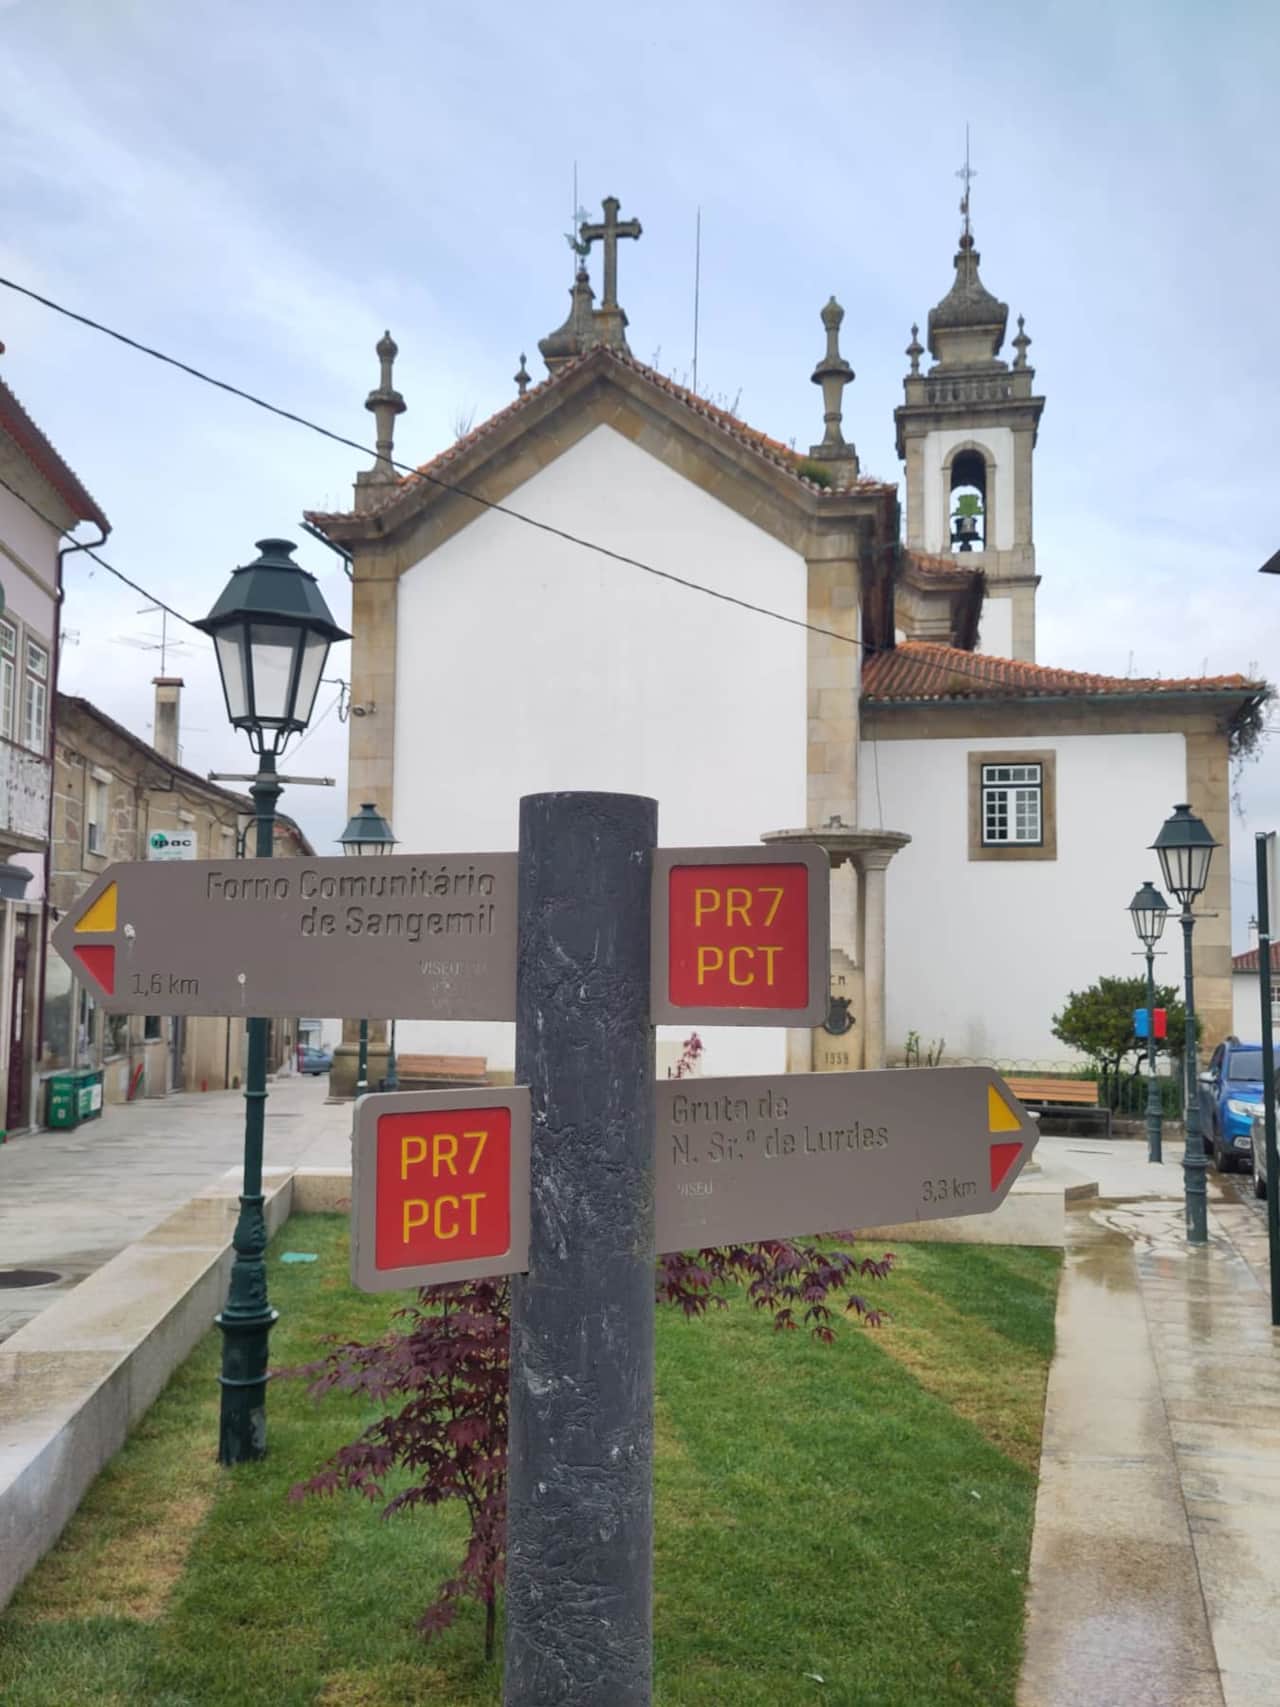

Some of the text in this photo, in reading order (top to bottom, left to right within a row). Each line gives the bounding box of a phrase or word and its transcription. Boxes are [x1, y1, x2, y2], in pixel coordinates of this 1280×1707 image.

[207, 865, 497, 900] Forno Comunitário
[301, 904, 496, 944] de Sangemil
[694, 887, 785, 928] PR7
[132, 973, 200, 997] 1,6 km
[696, 945, 785, 987] PCT
[672, 1088, 789, 1124] Gruta de
[401, 1131, 489, 1181] PR7
[765, 1127, 796, 1158] de
[803, 1120, 889, 1154] Lurdes
[921, 1177, 977, 1204] 3,3 km
[403, 1193, 488, 1244] PCT
